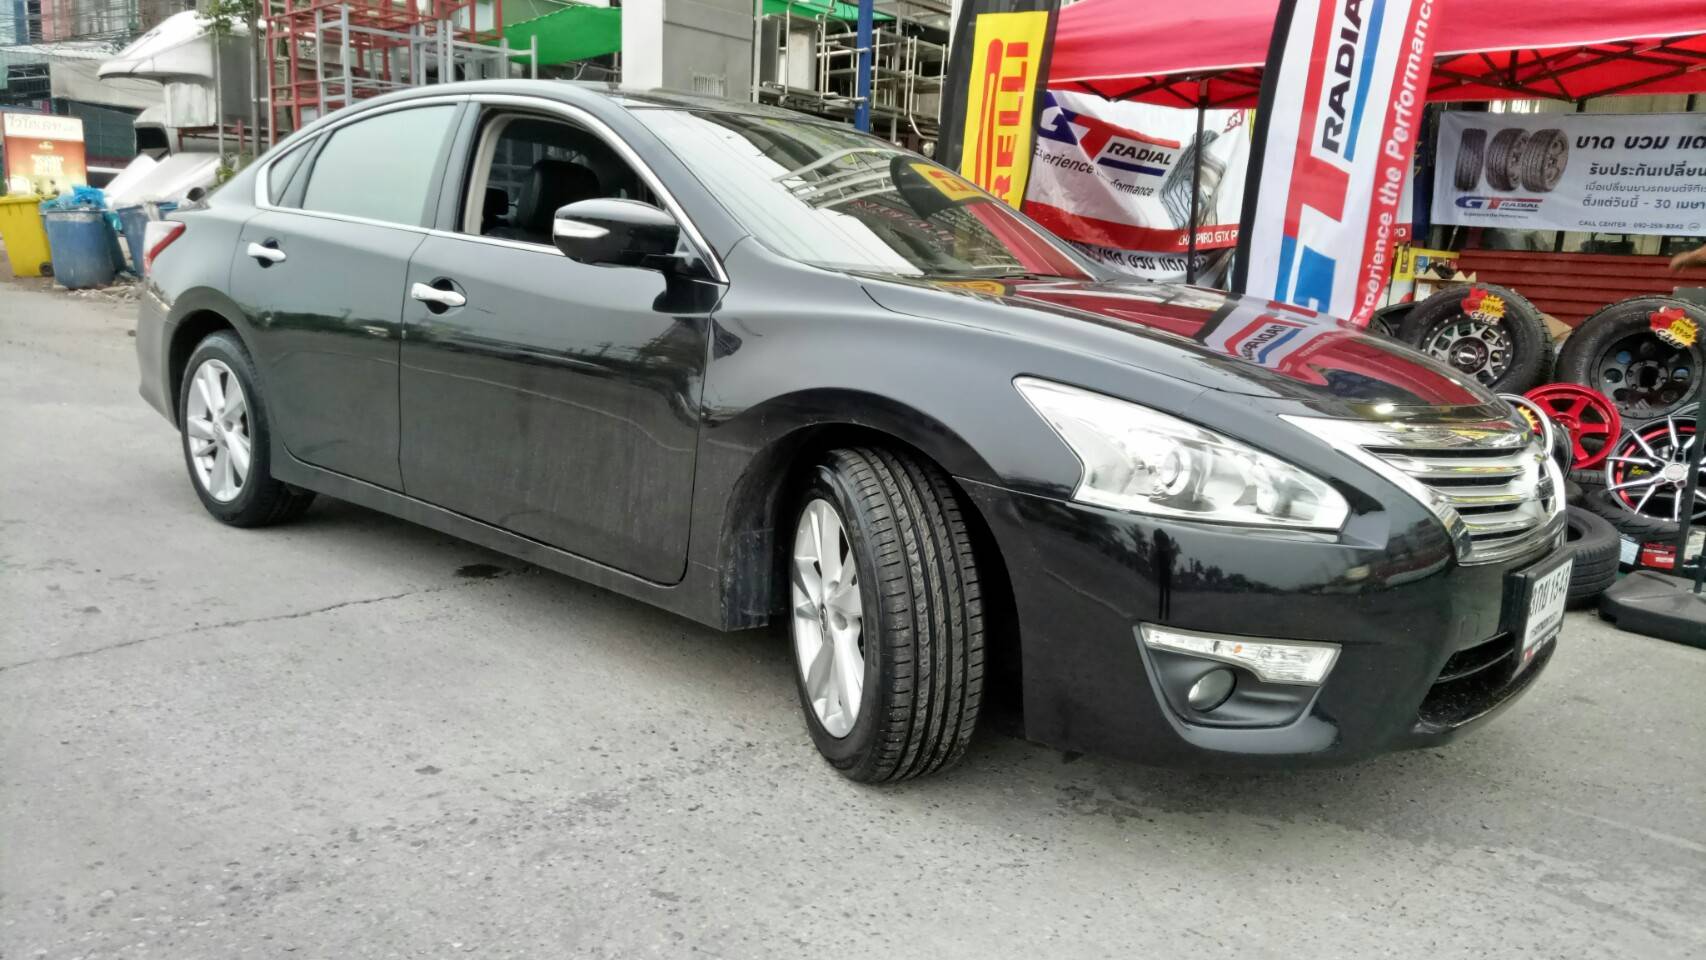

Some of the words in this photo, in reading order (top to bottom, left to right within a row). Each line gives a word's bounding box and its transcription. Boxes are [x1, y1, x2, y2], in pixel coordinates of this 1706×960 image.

[1624, 136, 1670, 150] บวม
[1106, 141, 1171, 166] RADIAL
[1379, 167, 1402, 206] the
[1654, 199, 1671, 209] 30
